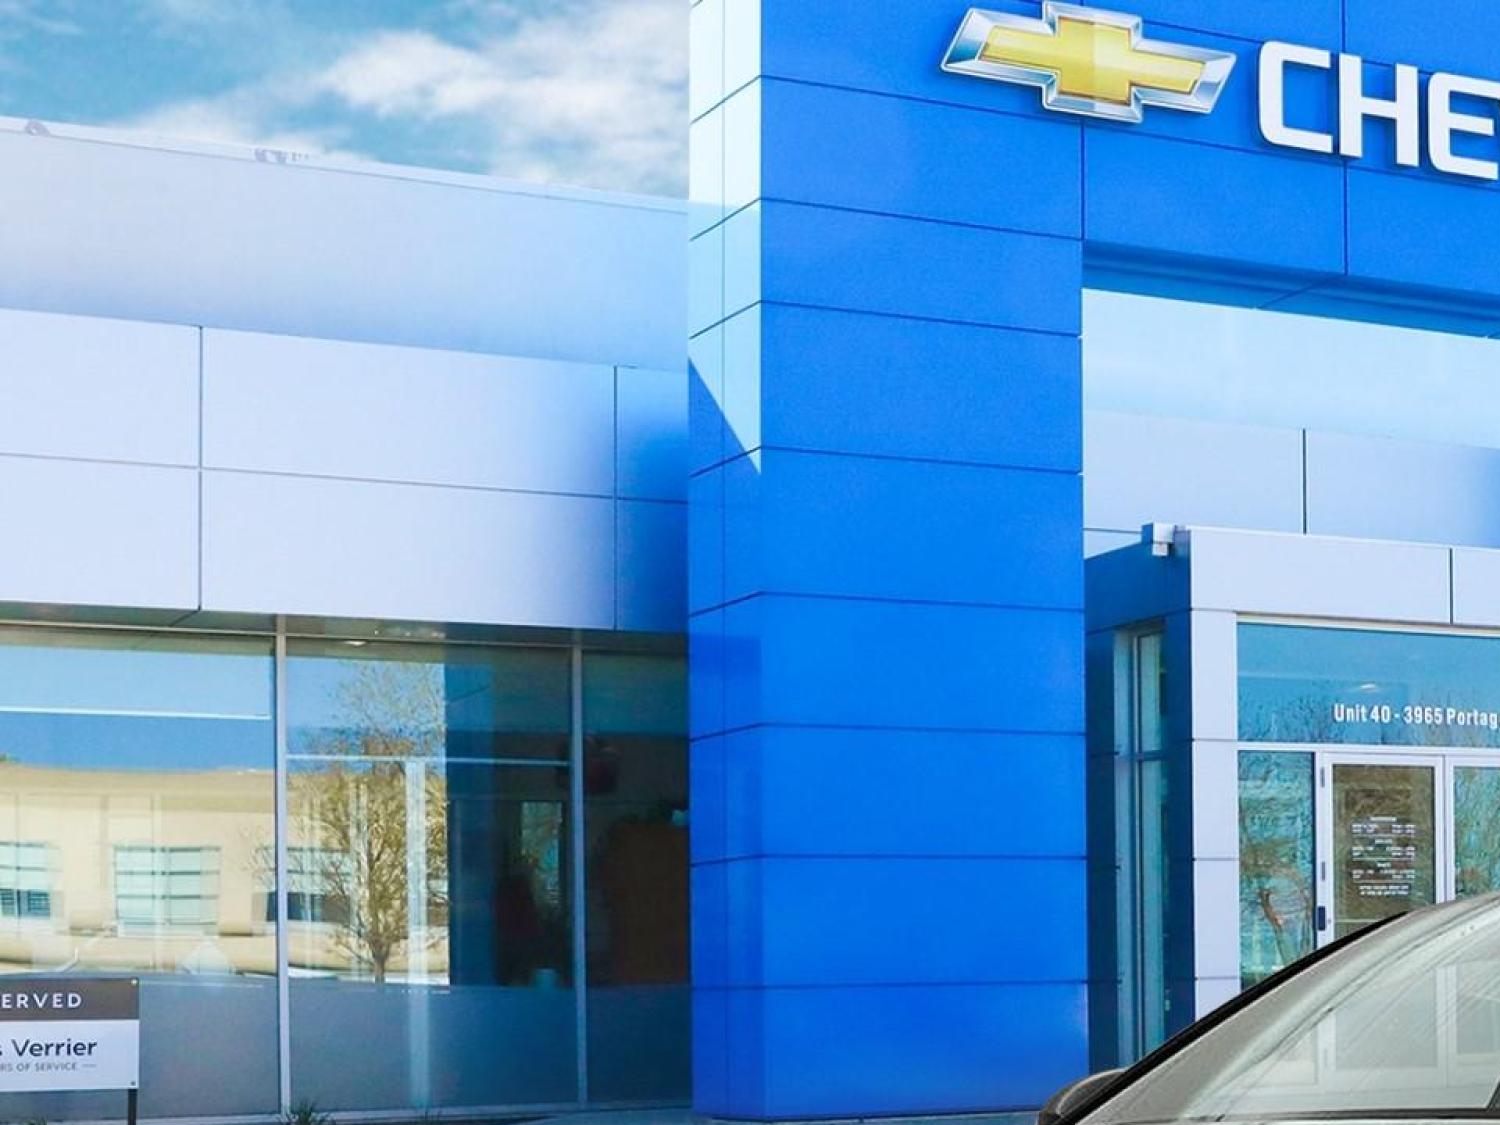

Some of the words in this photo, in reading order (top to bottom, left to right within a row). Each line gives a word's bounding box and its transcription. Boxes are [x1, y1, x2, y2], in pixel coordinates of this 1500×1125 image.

[1333, 703, 1367, 722] Unit
[1370, 704, 1391, 723] 40
[1402, 705, 1443, 725] 3965
[11, 1038, 97, 1057] Verrier
[16, 1062, 30, 1072] OF
[35, 1062, 77, 1072] SERVICE
